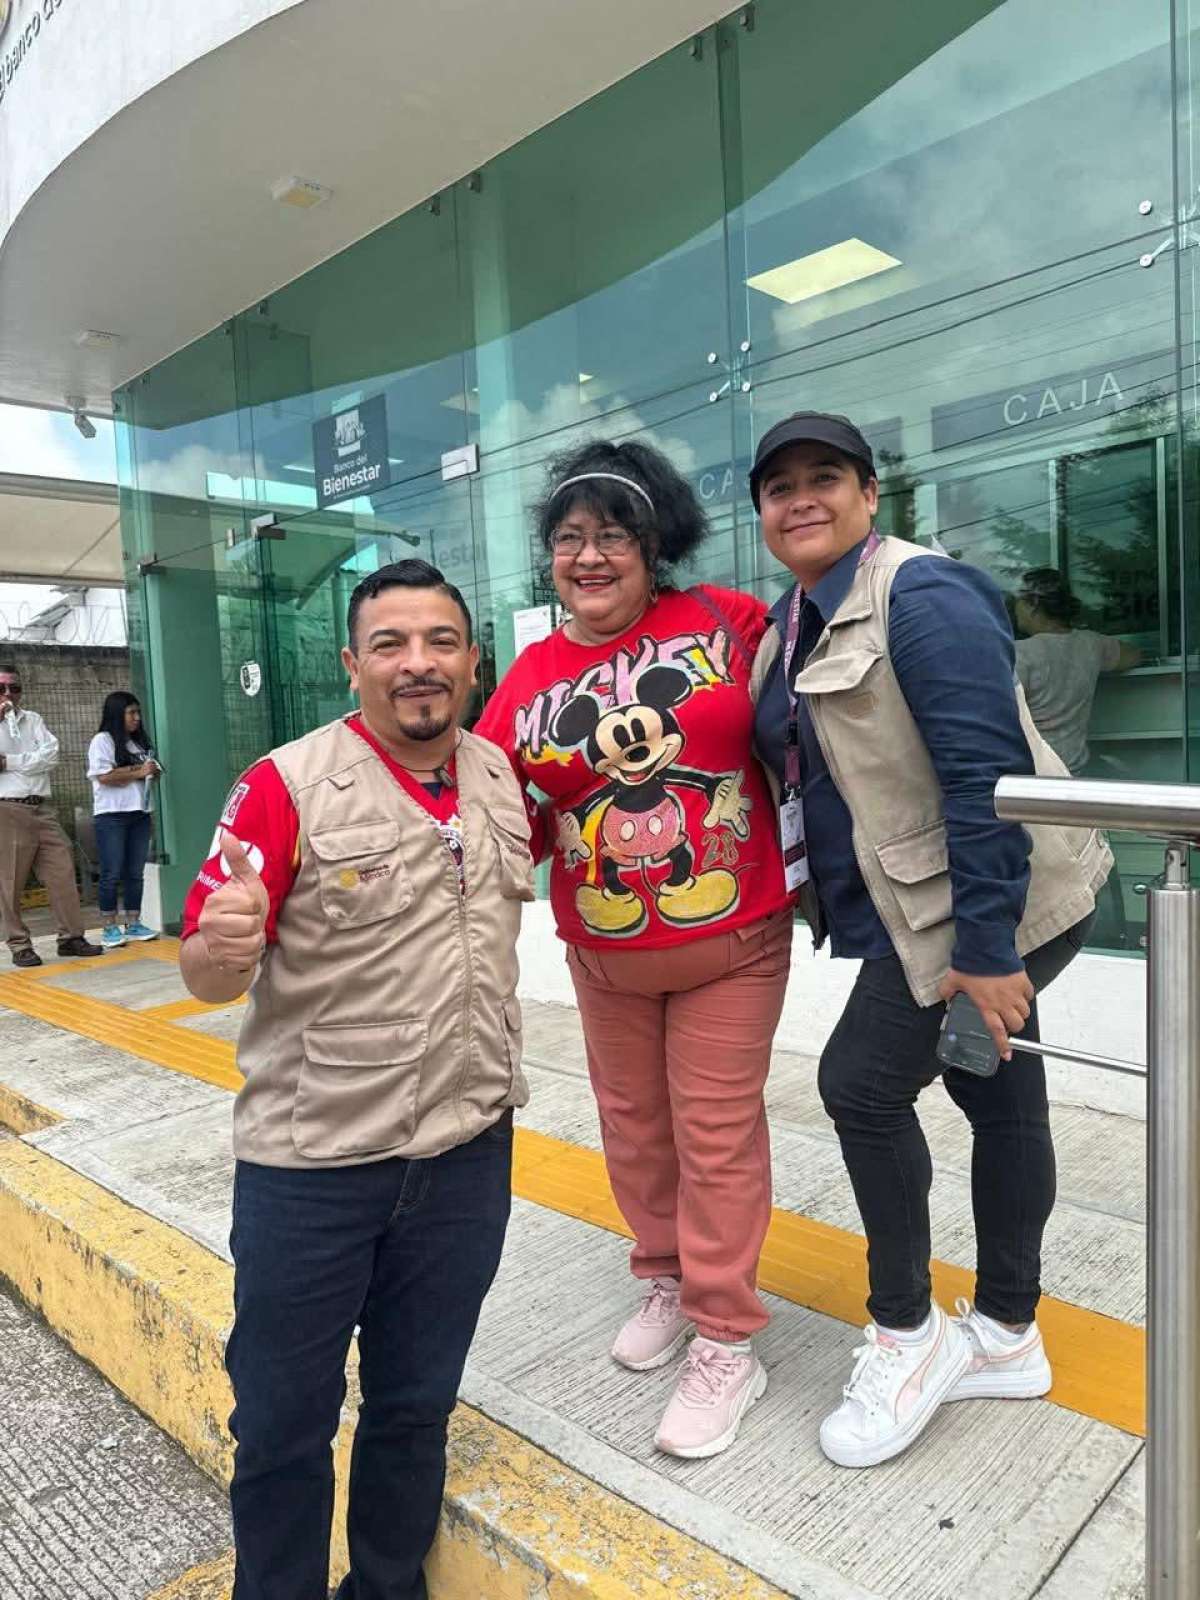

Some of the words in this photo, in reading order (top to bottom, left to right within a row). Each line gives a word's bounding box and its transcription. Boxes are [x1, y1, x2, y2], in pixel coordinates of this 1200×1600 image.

[6, 10, 41, 85] banco
[1003, 371, 1124, 426] CAJA
[323, 463, 381, 496] Bienestar
[701, 830, 739, 868] 28
